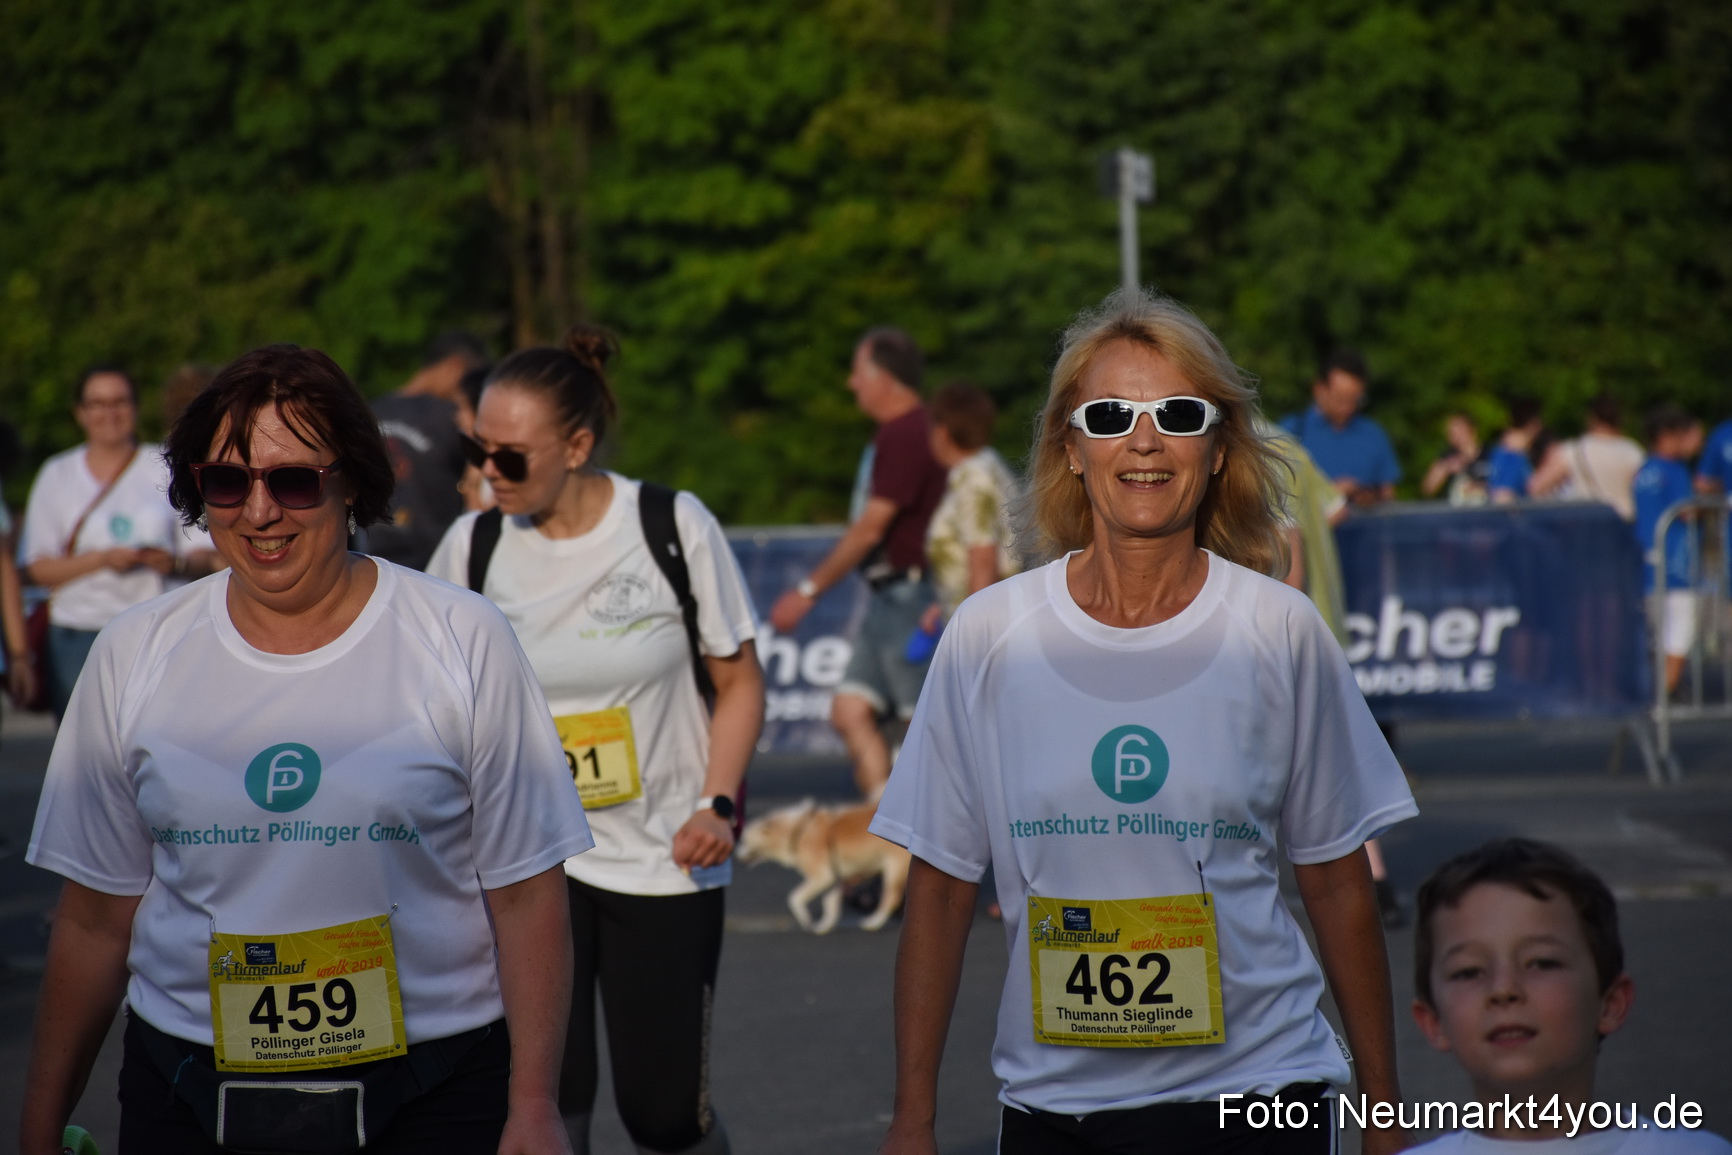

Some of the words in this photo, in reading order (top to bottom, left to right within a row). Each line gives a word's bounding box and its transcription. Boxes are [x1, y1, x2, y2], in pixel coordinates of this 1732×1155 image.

[1342, 595, 1521, 663] cher
[755, 622, 852, 687] he
[1354, 660, 1496, 696] MOBILE
[563, 747, 602, 780] 91
[151, 824, 260, 845] Datenschutz
[268, 821, 360, 847] Pöllinger
[368, 822, 421, 846] GmbH
[1009, 814, 1109, 838] atenschutz
[1117, 814, 1209, 842] Pöllinger
[1213, 819, 1262, 842] GmbH
[1053, 928, 1120, 943] firmenlauf
[1131, 934, 1164, 950] walk
[1168, 935, 1203, 949] 2019
[234, 959, 307, 976] firmenlauf
[317, 959, 349, 978] walk
[351, 956, 383, 972] 2019
[1066, 952, 1174, 1006] 462
[249, 978, 357, 1034] 459
[1056, 1006, 1118, 1021] Thumann
[1123, 1006, 1193, 1023] Sieglinde
[251, 1034, 315, 1050] Pöllinger
[320, 1028, 365, 1045] Gisela
[1071, 1023, 1128, 1034] Datenschutz
[1130, 1024, 1176, 1034] Pöllinger
[255, 1048, 316, 1060] Datenschutz
[318, 1043, 362, 1056] Pöllinger
